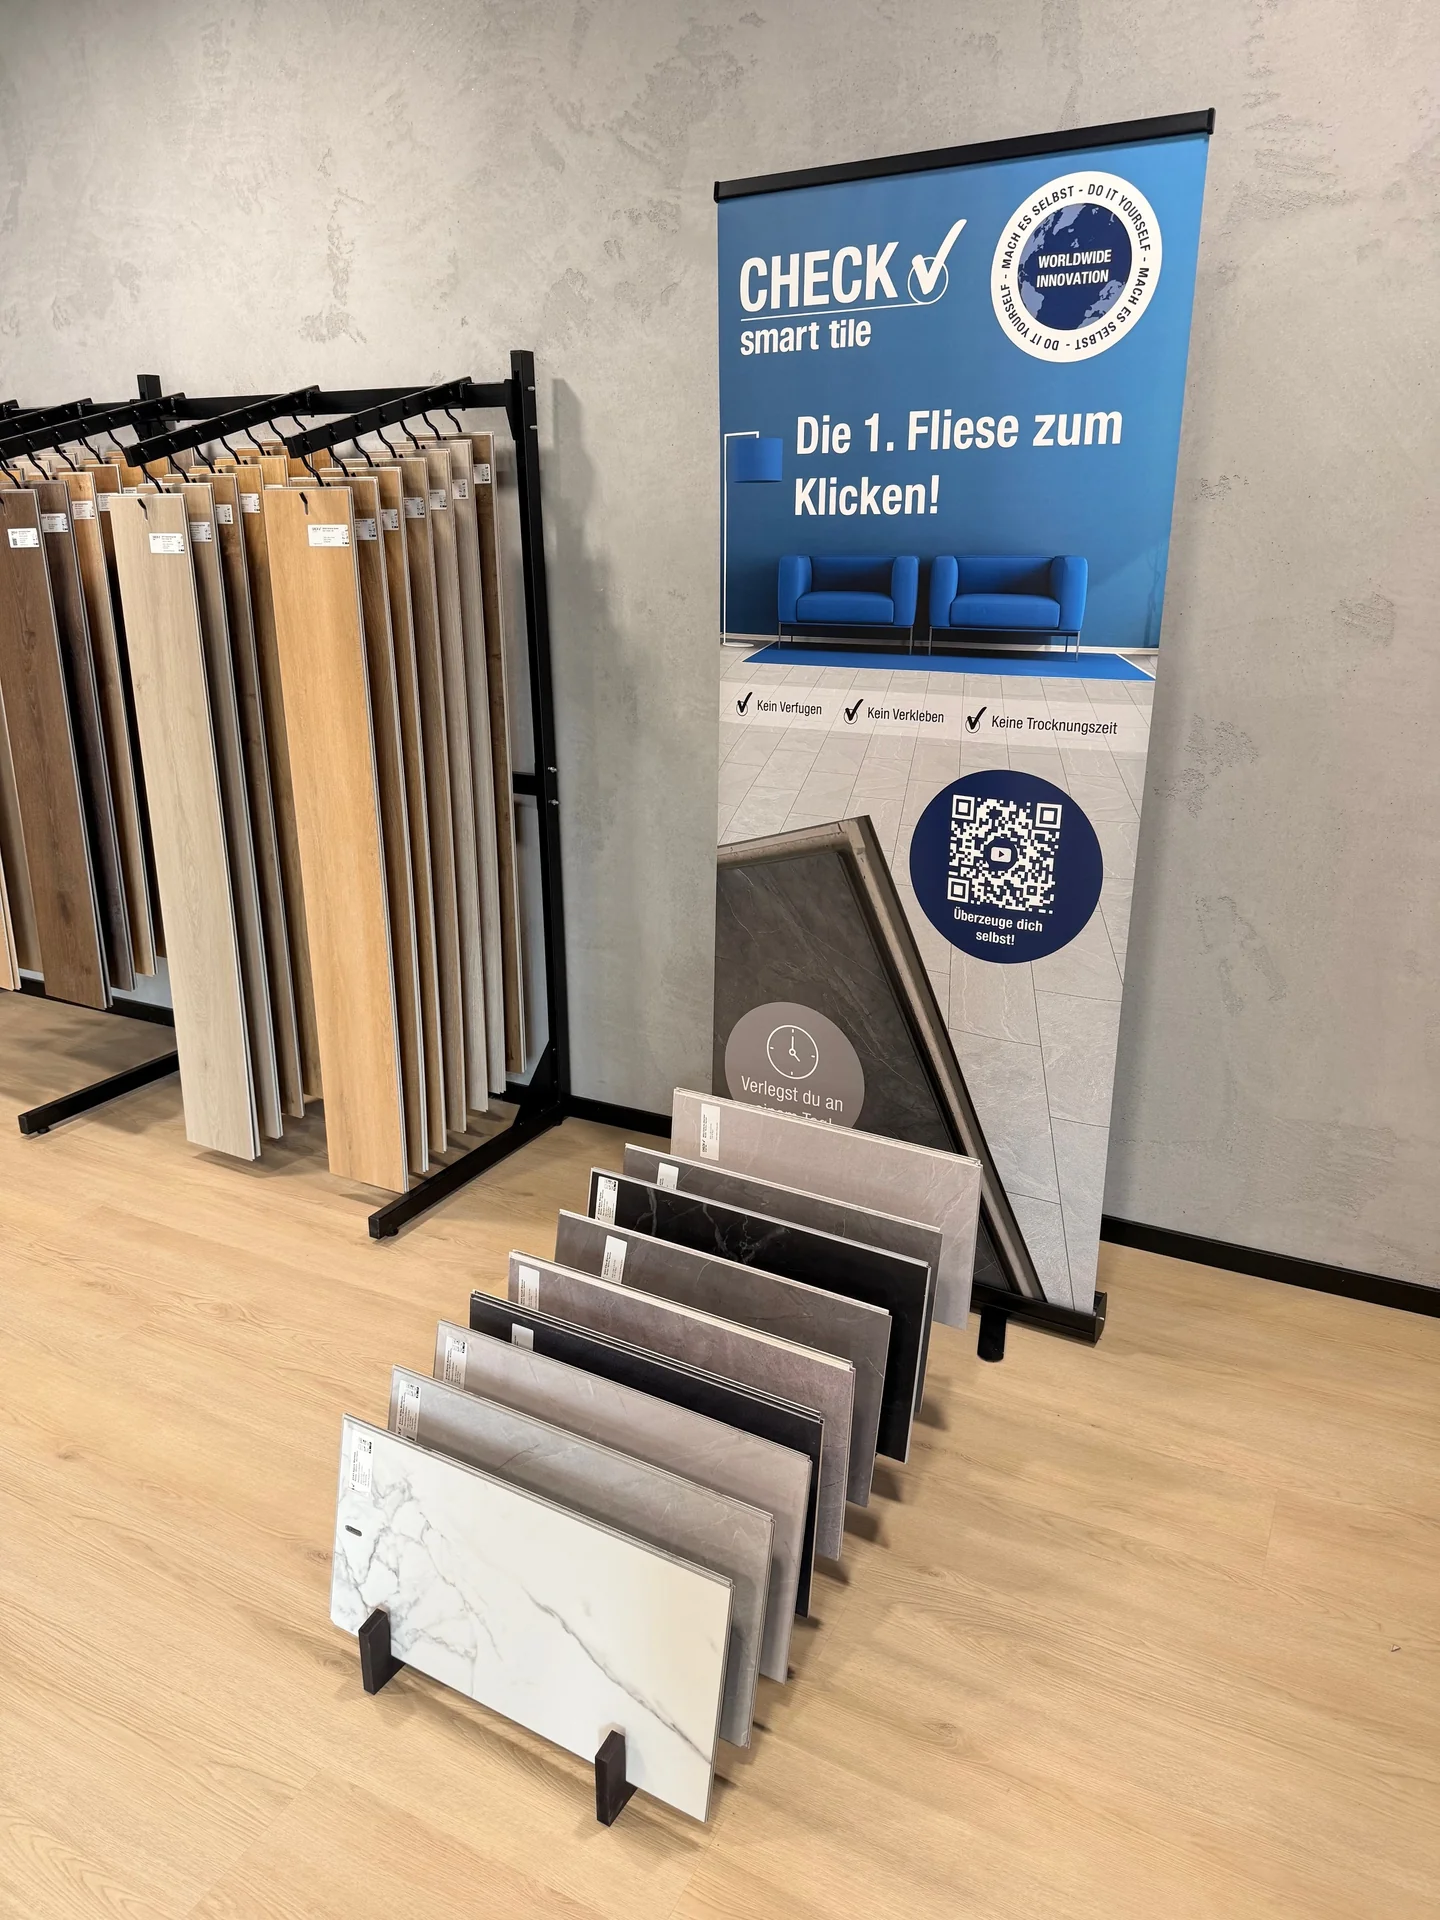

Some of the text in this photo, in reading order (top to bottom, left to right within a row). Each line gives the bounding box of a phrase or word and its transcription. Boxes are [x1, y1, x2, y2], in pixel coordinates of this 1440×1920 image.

[1032, 185, 1074, 216] SELBST
[1087, 184, 1104, 196] DO
[1105, 187, 1118, 201] IT
[1018, 214, 1032, 231] ES
[1117, 194, 1151, 252] YOURSELF
[1002, 232, 1021, 269] MACH
[1038, 249, 1112, 269] WORLDWIDE
[740, 241, 899, 312] CHECK
[1036, 269, 1109, 288] INNOVATION
[1128, 267, 1149, 306] MACH
[1000, 284, 1030, 339] YOURSELF
[1116, 306, 1132, 323] ES
[740, 318, 872, 356] smart tile
[1030, 335, 1042, 348] IT
[1044, 338, 1060, 351] DO
[1074, 321, 1117, 350] SELBST
[796, 409, 1123, 455] Die 1. Fliese zum
[794, 474, 940, 516] Klicken!
[757, 700, 822, 716] Kein Verfugen
[867, 707, 944, 723] Kein Verkleben
[991, 715, 1118, 735] Keine Trocknungszeit
[954, 906, 1043, 932] Überzeuge dich
[976, 931, 1015, 945] selbst!
[741, 1075, 843, 1112] Verlegst du an
